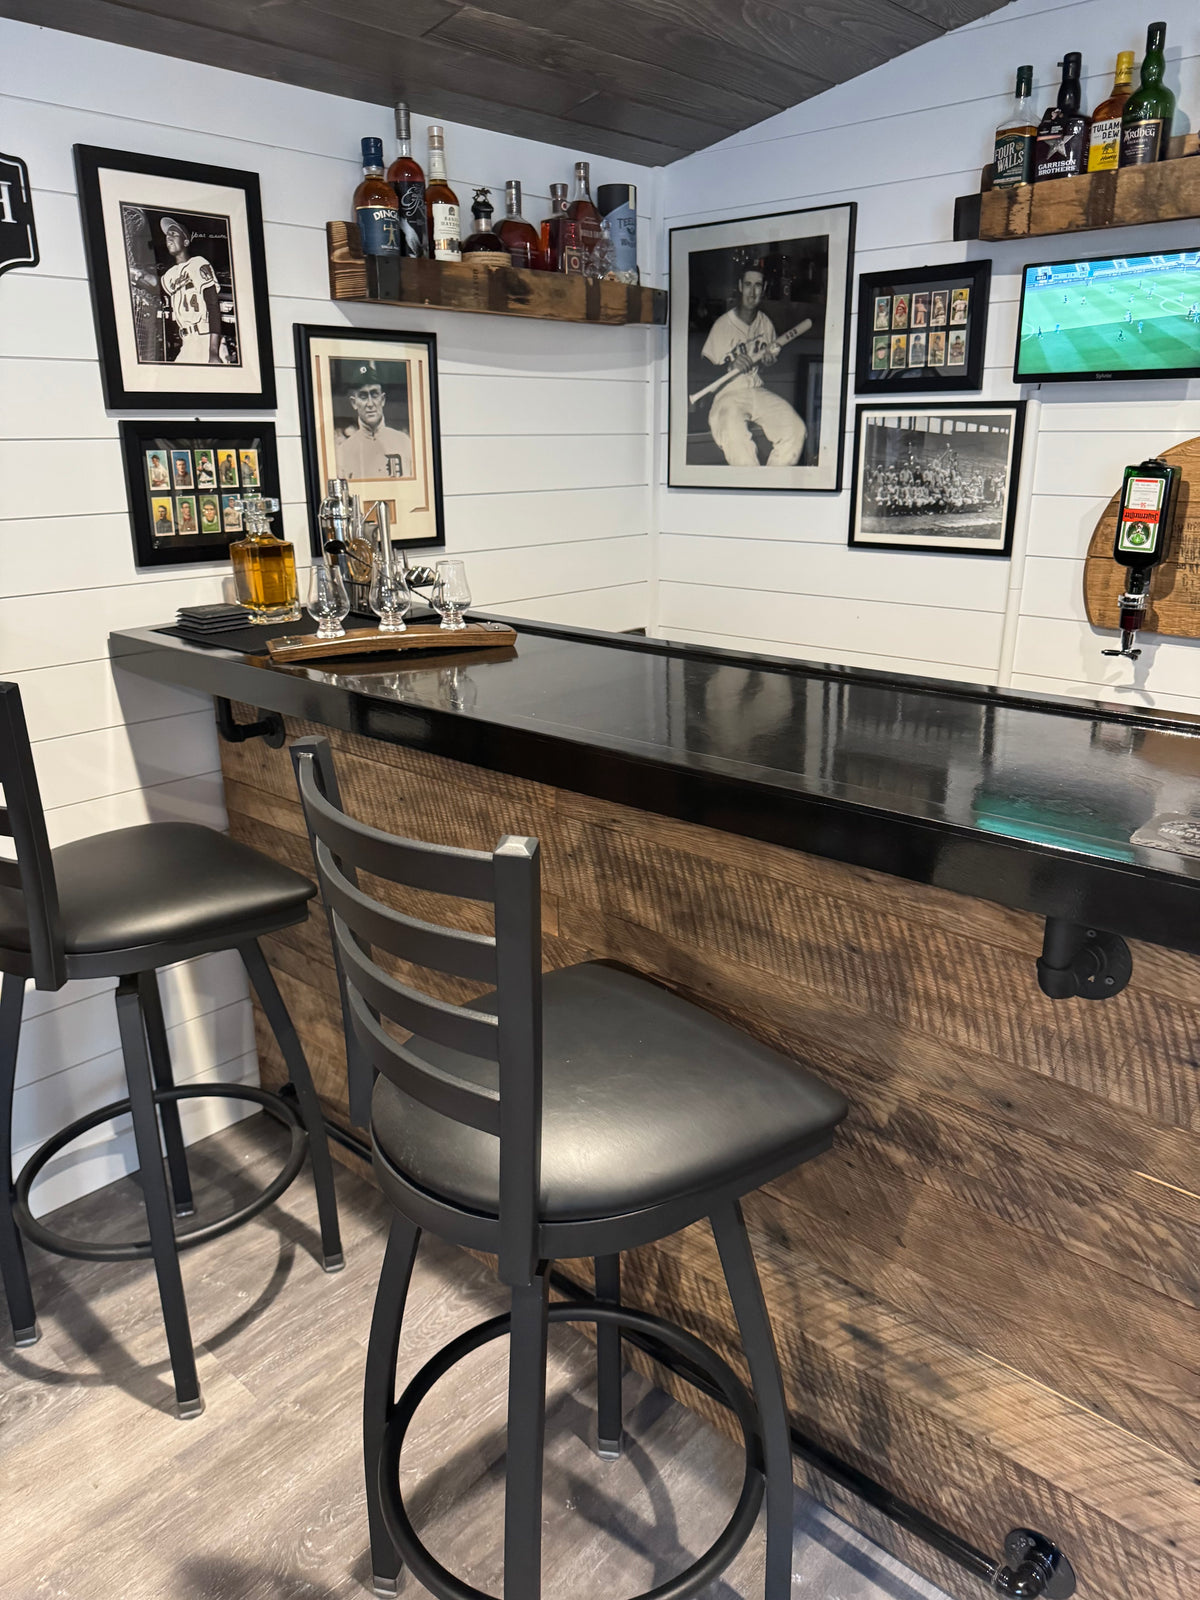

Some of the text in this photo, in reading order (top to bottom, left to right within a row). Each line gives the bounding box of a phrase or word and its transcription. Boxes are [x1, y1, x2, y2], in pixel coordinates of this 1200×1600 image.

[1093, 122, 1121, 134] TULLAM
[994, 142, 1015, 162] FOUR
[997, 150, 1024, 173] WALLS
[1038, 159, 1077, 171] GARRISON
[1038, 166, 1077, 177] BROTHERS
[385, 453, 403, 477] D
